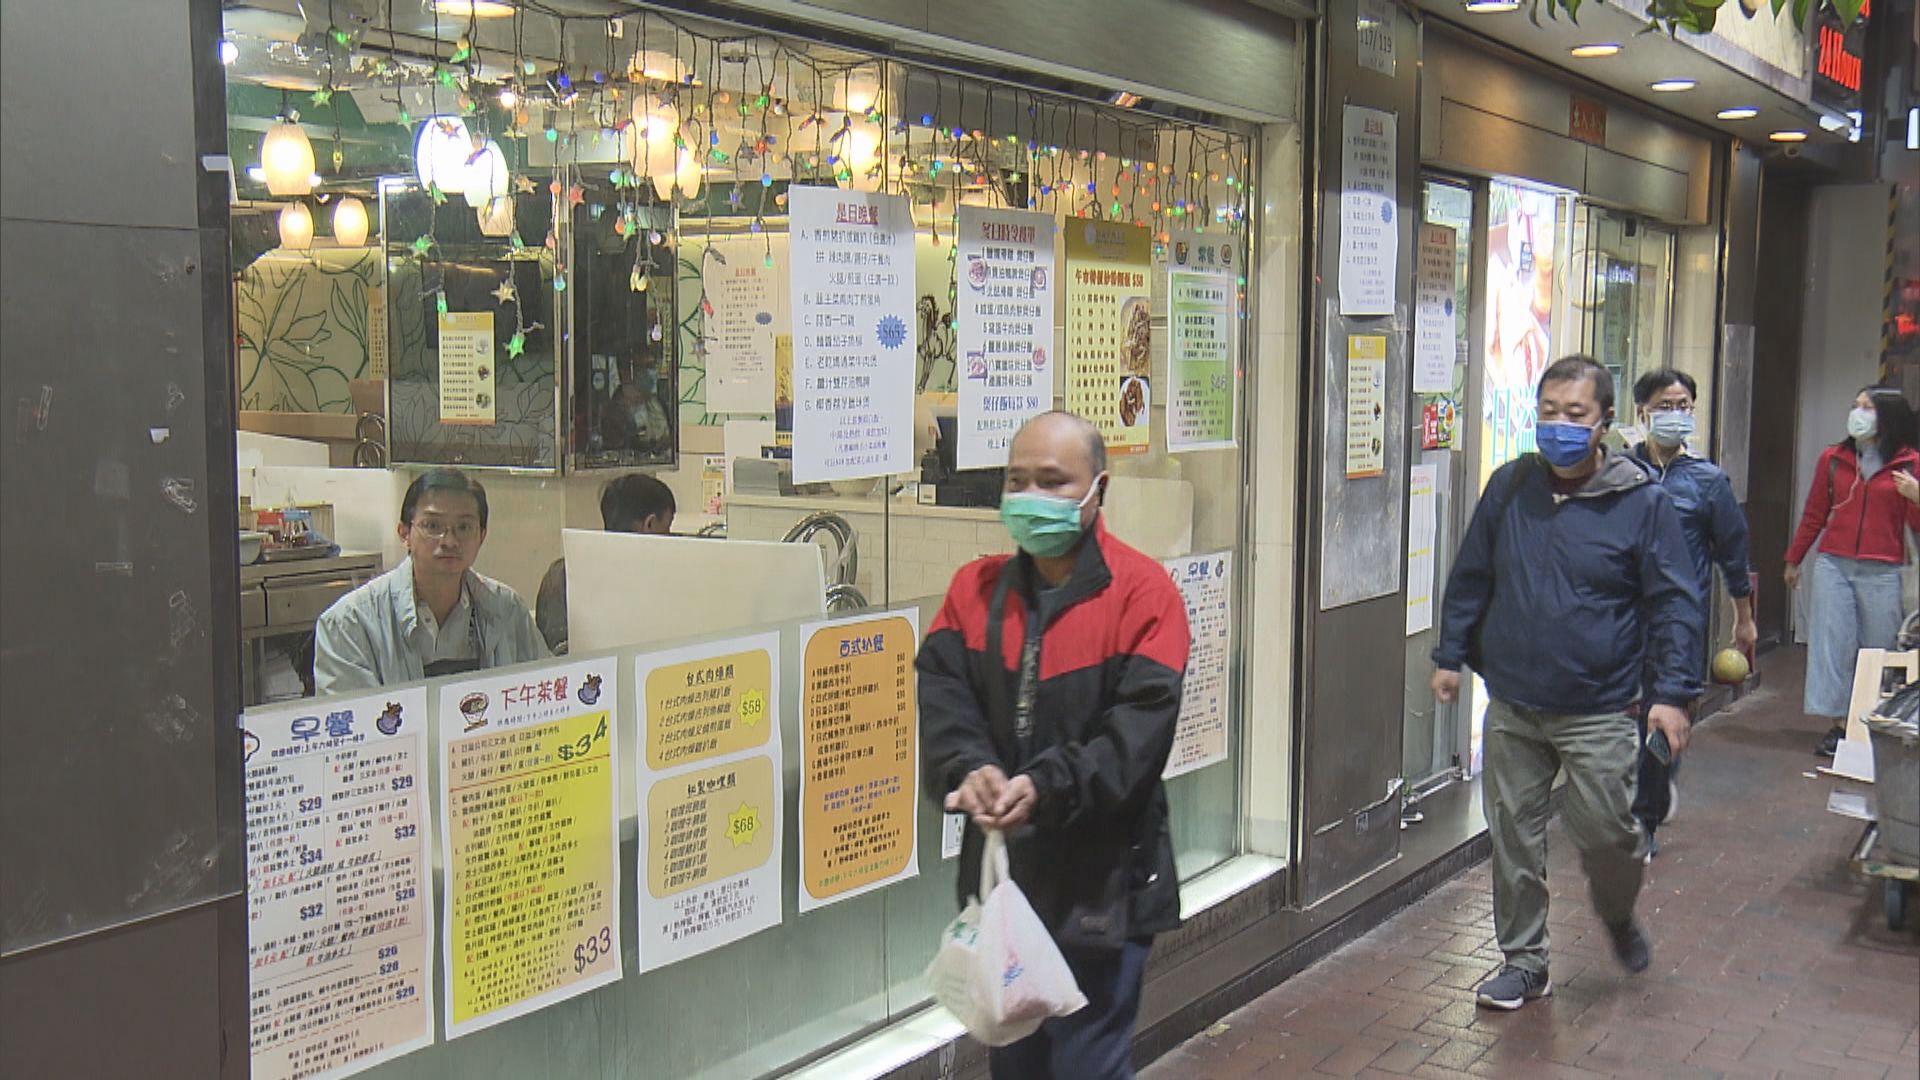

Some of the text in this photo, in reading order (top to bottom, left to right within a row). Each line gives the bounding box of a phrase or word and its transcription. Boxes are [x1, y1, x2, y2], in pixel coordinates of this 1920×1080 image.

[836, 202, 878, 225] 是日晚餐
[840, 633, 883, 658] 西式扒餐
[501, 676, 568, 710] 下午茶餐
[742, 697, 760, 716] $58
[291, 710, 354, 742] 早餐
[558, 715, 608, 761] $34
[391, 772, 413, 791] $29
[298, 795, 321, 814] $29
[394, 822, 415, 840] $32
[733, 814, 753, 835] $68
[299, 847, 322, 866] $34
[299, 901, 323, 921] $32
[574, 926, 612, 975] $33
